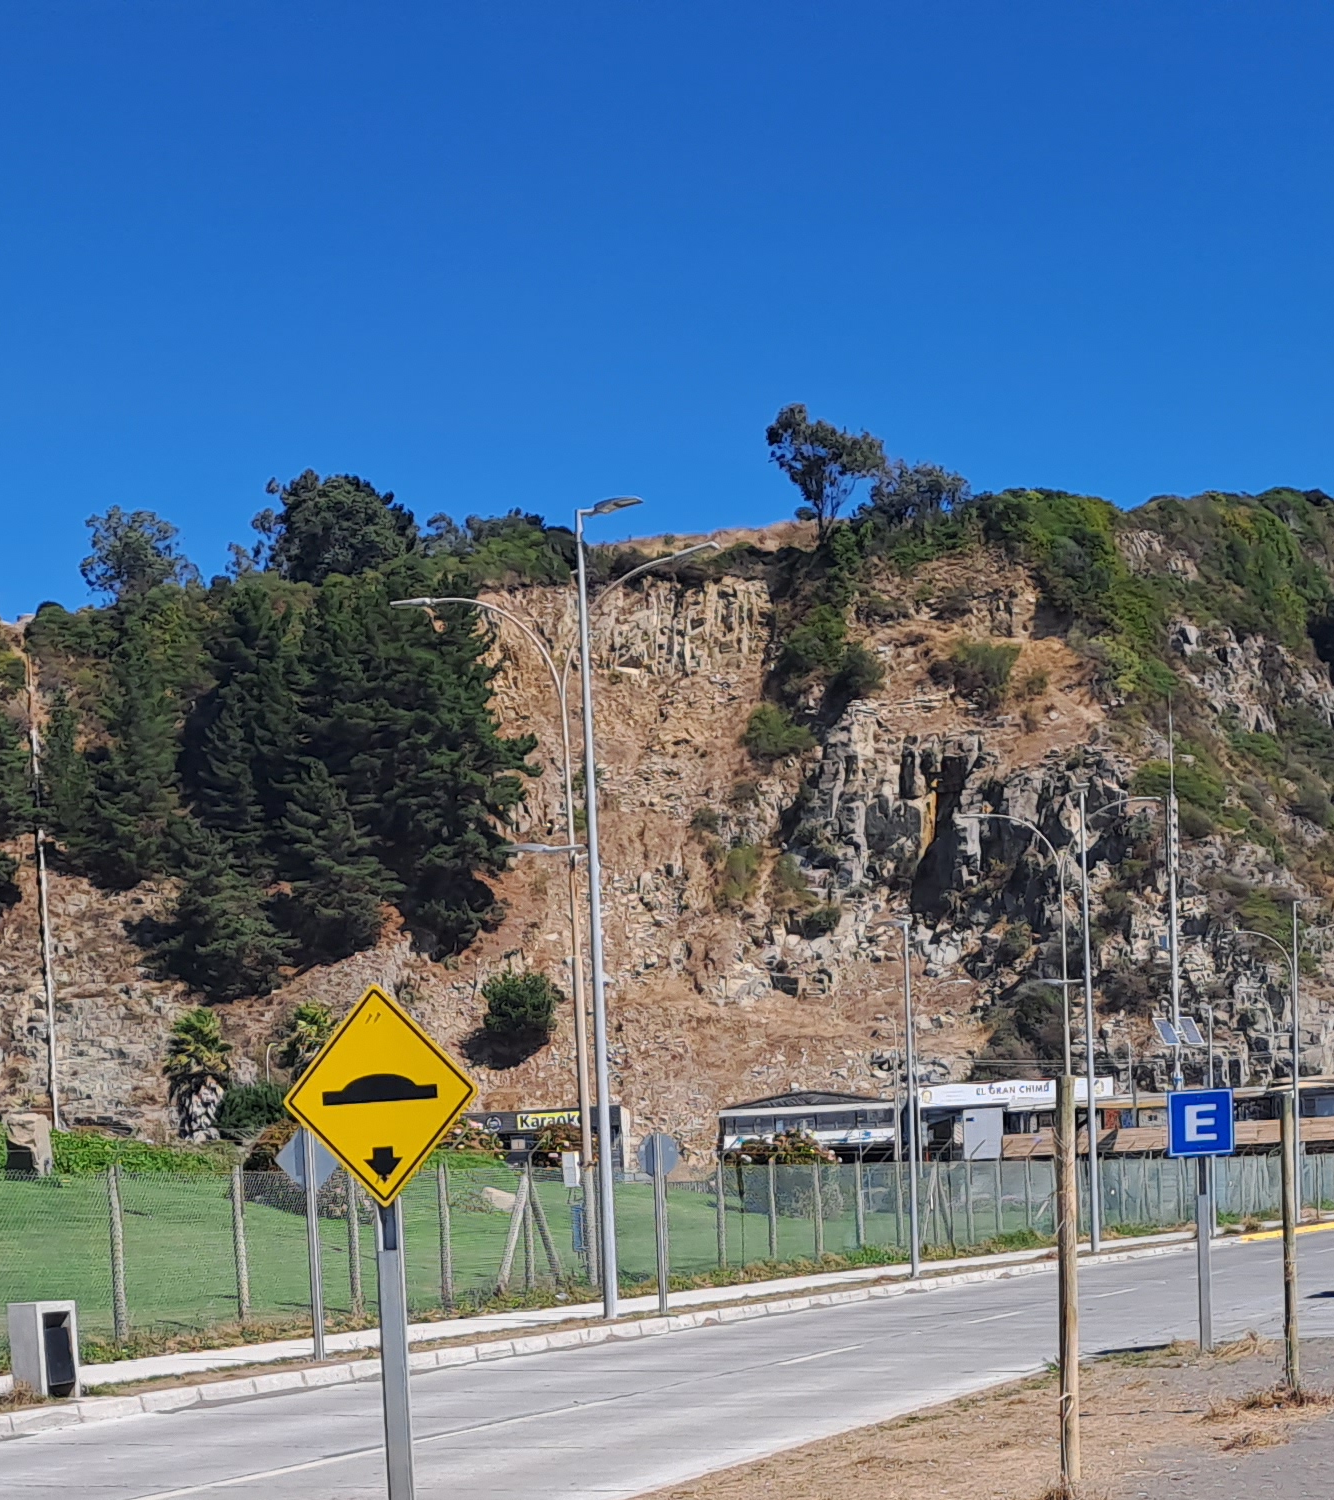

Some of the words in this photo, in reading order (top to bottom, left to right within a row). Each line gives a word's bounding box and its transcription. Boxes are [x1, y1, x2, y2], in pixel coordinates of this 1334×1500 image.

[976, 1087, 986, 1095] EL
[988, 1084, 1016, 1095] GRAN
[1185, 1103, 1218, 1142] E
